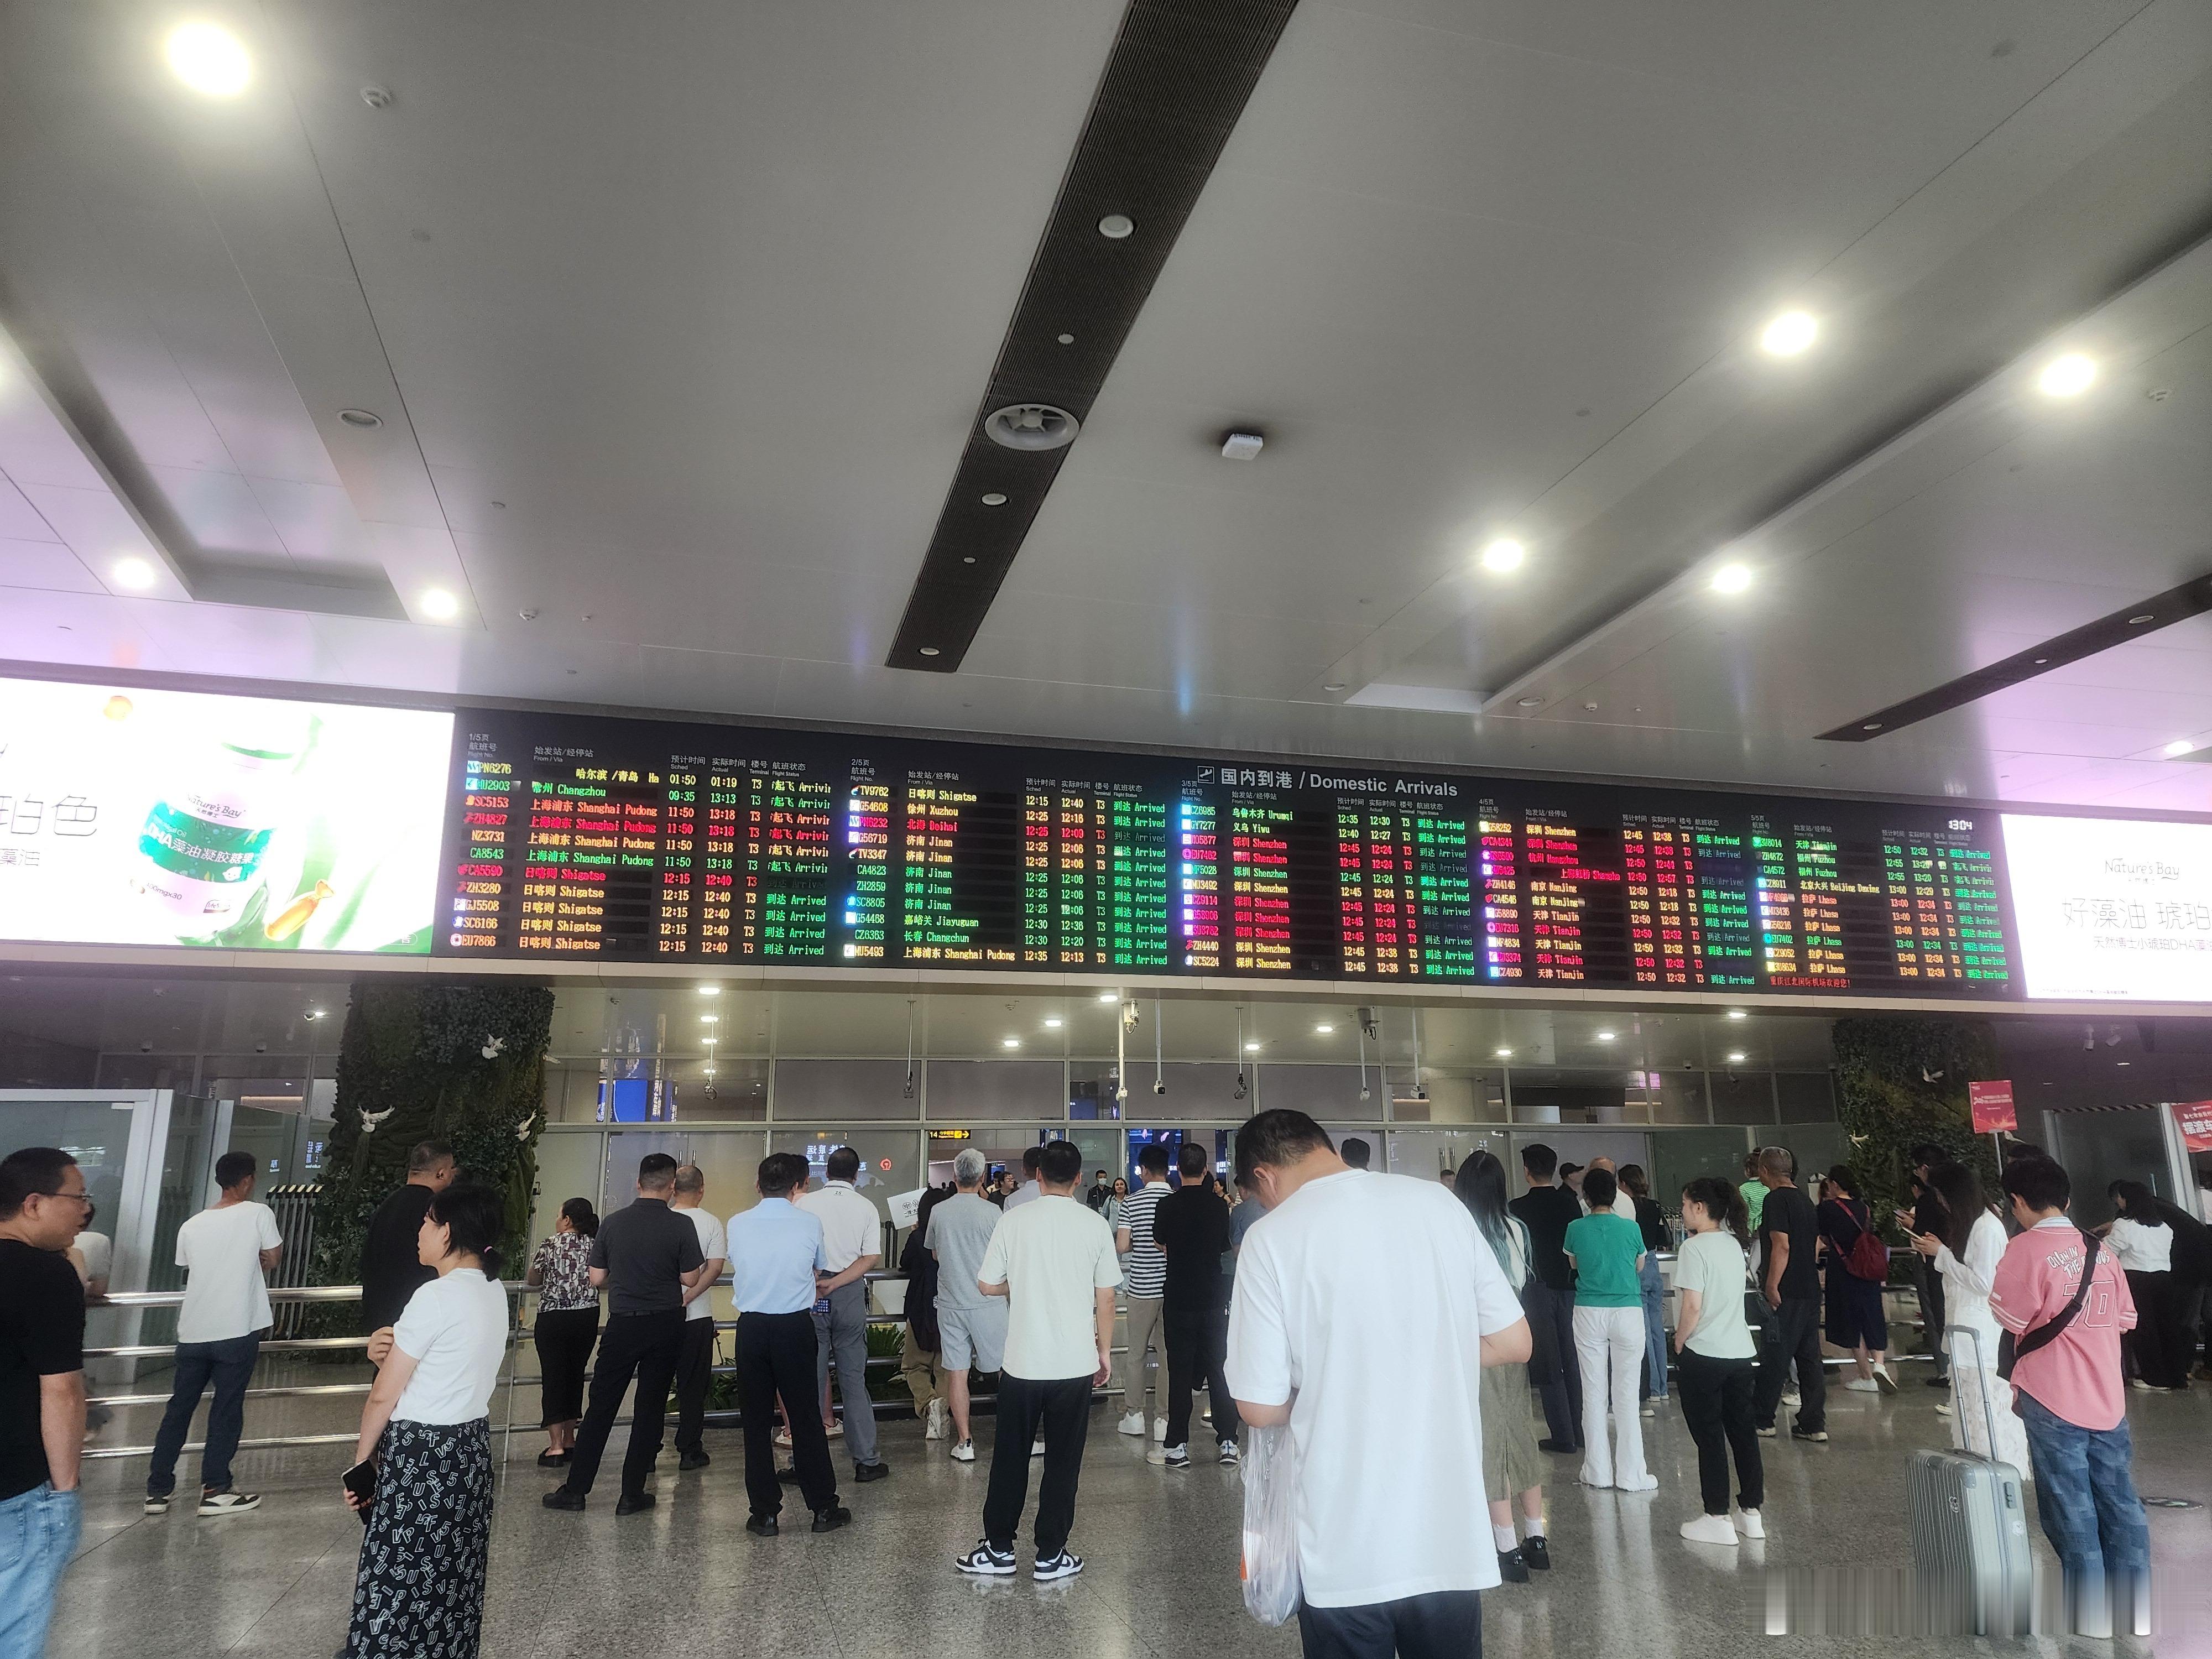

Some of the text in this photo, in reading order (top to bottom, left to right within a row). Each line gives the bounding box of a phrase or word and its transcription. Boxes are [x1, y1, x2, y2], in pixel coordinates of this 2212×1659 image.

[469, 742, 806, 770] 航班号 始发站/经停站 预计时间 实际时间 楼号 航班状态
[479, 763, 512, 774] PN6276
[576, 768, 607, 780] 哈尔滨
[670, 774, 696, 785] 01:50
[711, 776, 737, 787] 01:19
[752, 779, 761, 789] T3
[851, 766, 875, 775] 航班号
[907, 770, 959, 781] 始发站/经停站
[1026, 778, 1056, 787] 预计时间
[1061, 780, 1090, 789] 实际时间
[1114, 784, 1142, 792] 航班状态
[1222, 768, 1457, 796] 国内到港 / Domestic Arrivals
[860, 786, 1165, 812] TV9762 日喀则 Shigatse 12:15 12:40 T3 到达 Arrived
[221, 806, 242, 818] Bay
[859, 801, 1165, 827] G54608 徐州 Xuzhou 12:25 T3 到达 Arrived
[1191, 805, 1464, 830] CZ6985 乌鲁木齐 Urumqi 12:35 12:30 T3 到达 Arrived
[1191, 820, 1465, 844] GY7277 义乌 Yiwu 12:40 12:27 T3 到达 Arrived
[1526, 825, 1542, 834] 深圳
[1545, 826, 1576, 836] Shenzhen
[1624, 830, 1642, 839] 12:45
[1653, 832, 1672, 841] 12:38
[1682, 833, 1689, 842] T3
[1697, 834, 1711, 843] 到达
[1715, 836, 1740, 845] Arrived
[470, 848, 758, 870] CA8543 上海浦东 Shanghai Pudong 11:50 13:18 T3
[2156, 862, 2179, 880] Bay
[465, 882, 826, 905] ZH3280 日喀则 Shigatse 12:15 12:40 T3 到达 Arrived
[1532, 895, 1547, 906] 南京
[1551, 897, 1580, 907] Nanjing
[1630, 901, 1649, 910] 12:50
[1660, 902, 1678, 911] 12:18
[1688, 903, 1697, 912] T3
[1704, 904, 1719, 913] 到达
[1721, 905, 1747, 914] Arrived
[2062, 894, 2147, 929] 好藻油
[855, 930, 1167, 949] CZ6363 长春 Changchun 12:30 12:20 T3 到达 Arrived
[2063, 1258, 2081, 1281] THE
